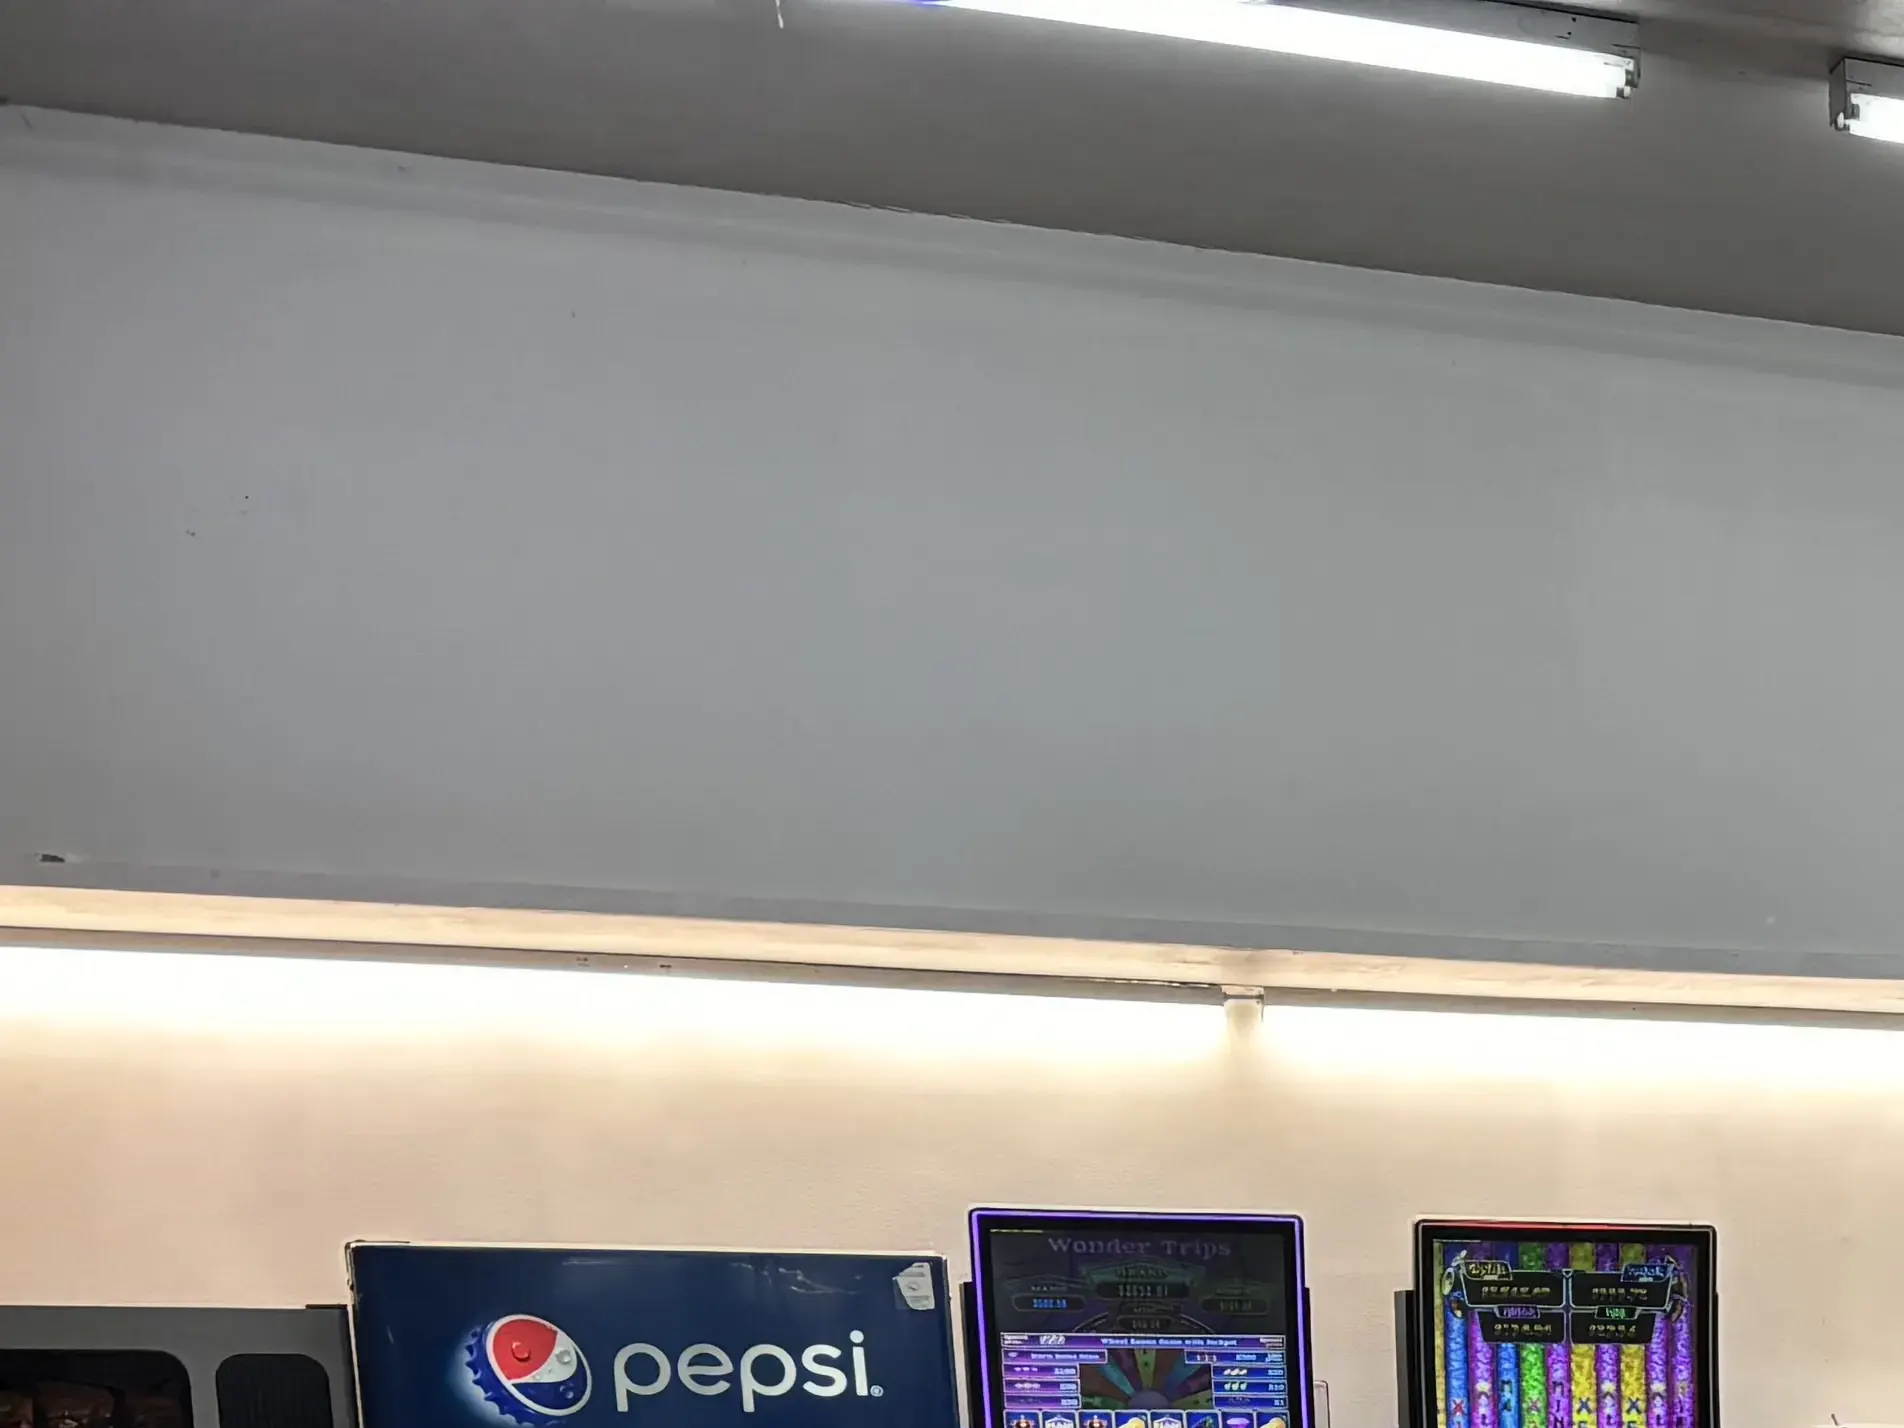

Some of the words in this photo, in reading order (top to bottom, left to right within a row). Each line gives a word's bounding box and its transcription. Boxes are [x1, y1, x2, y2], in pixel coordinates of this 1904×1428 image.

[1048, 1237, 1151, 1255] Wonder
[1161, 1240, 1233, 1260] Trips
[614, 1330, 869, 1412] pepsi
